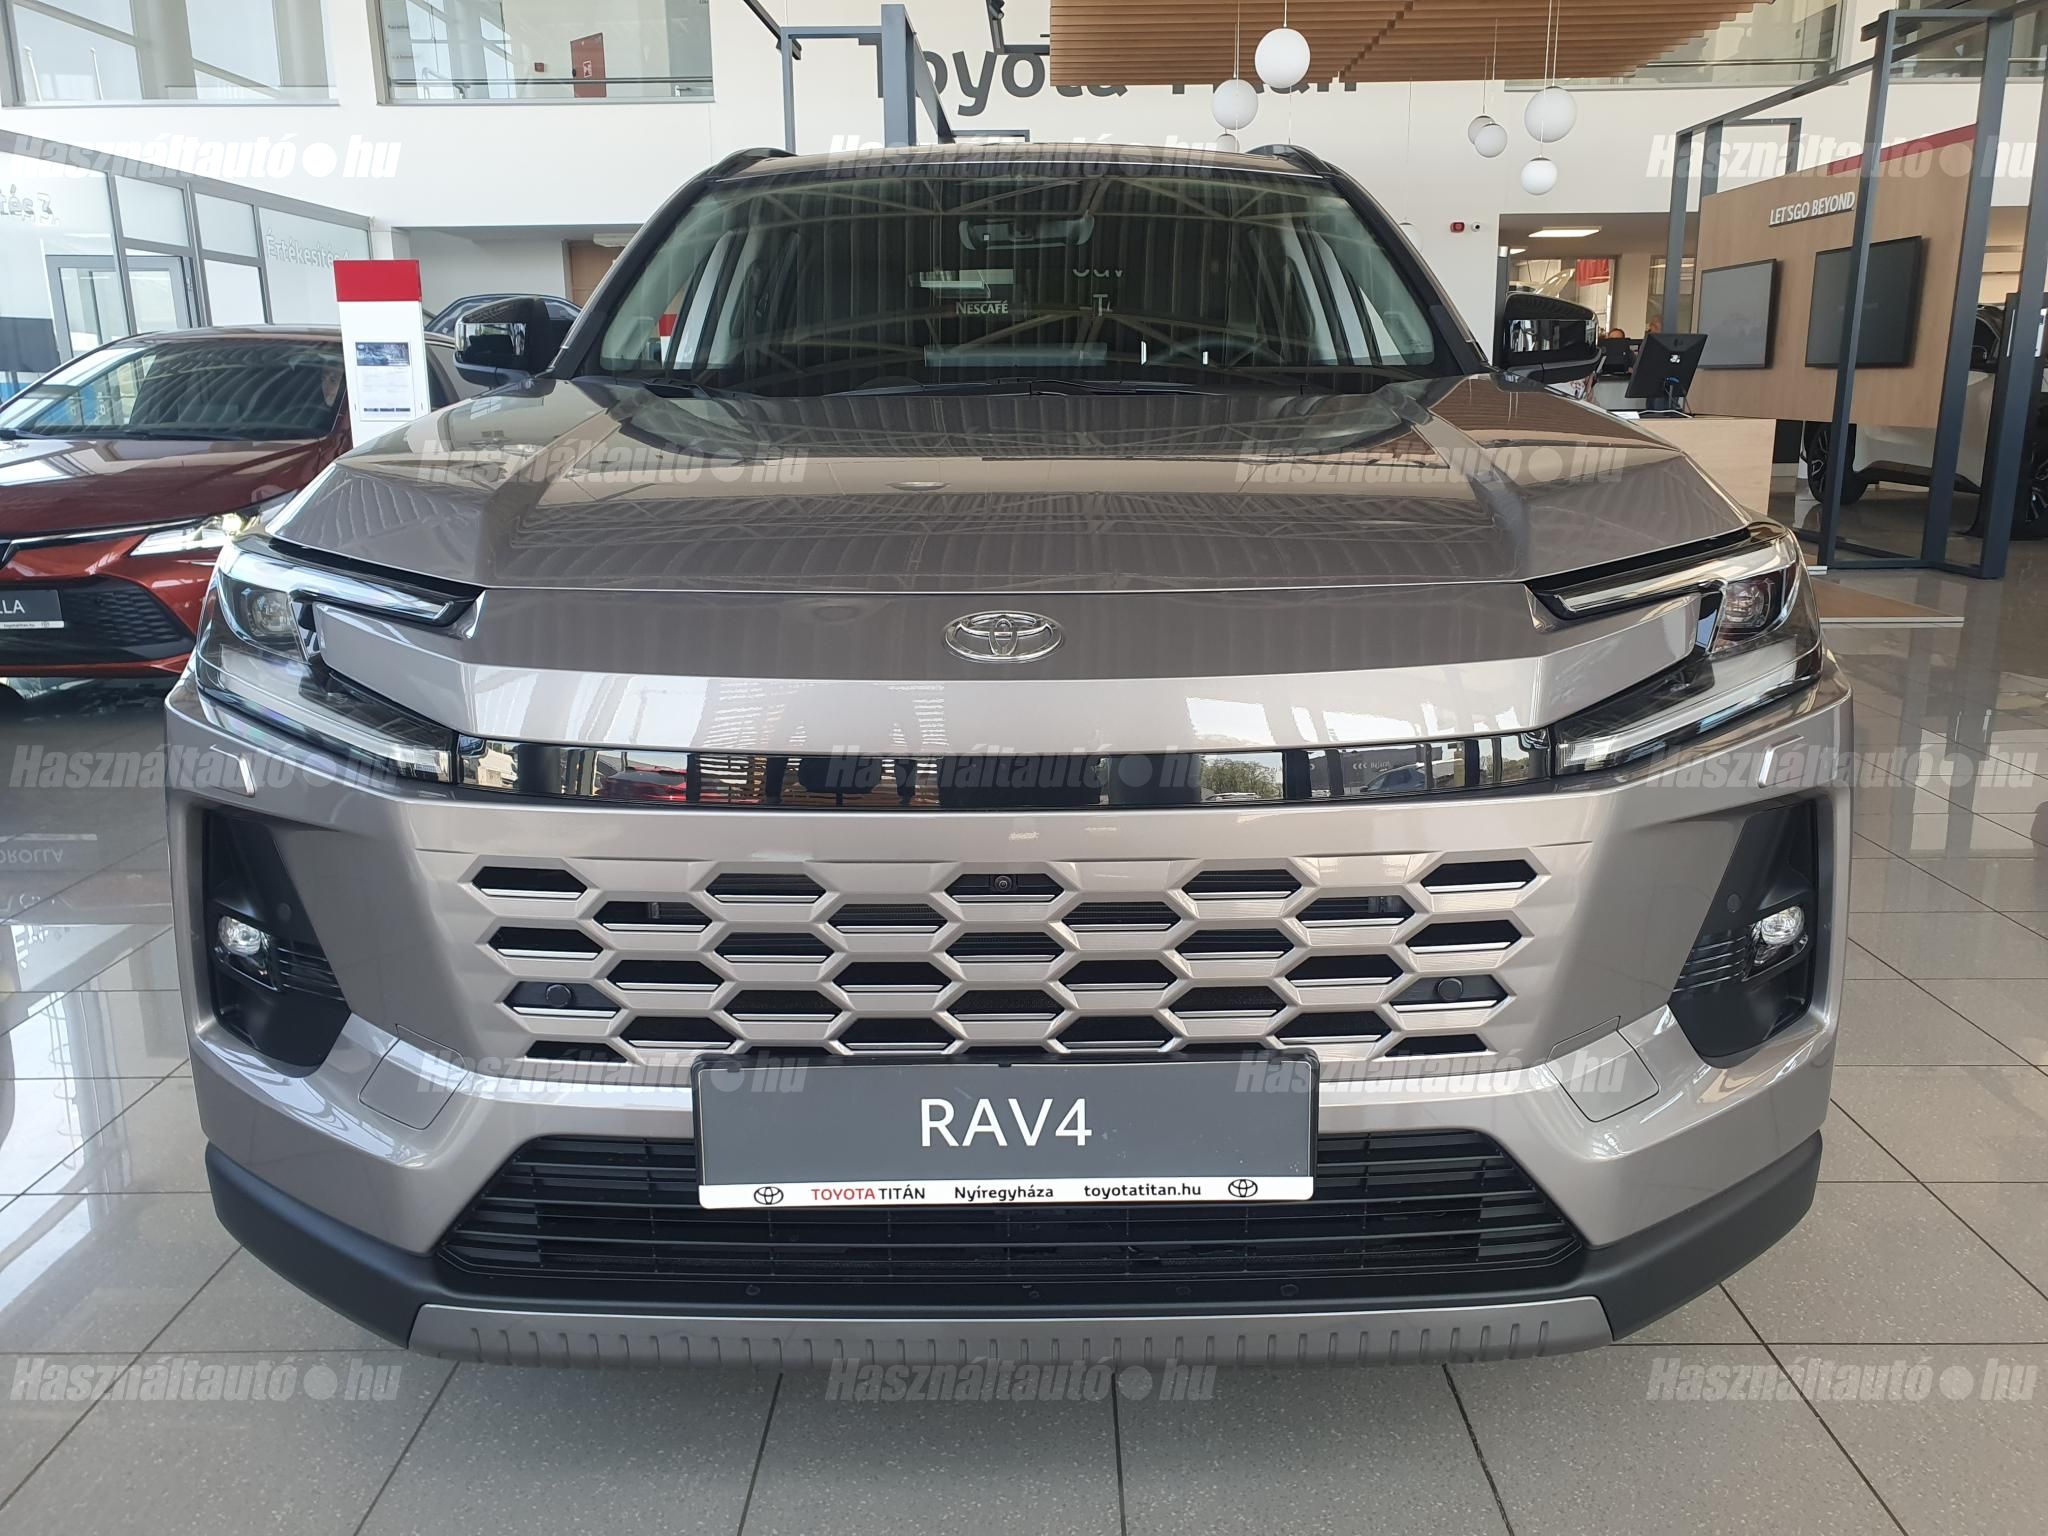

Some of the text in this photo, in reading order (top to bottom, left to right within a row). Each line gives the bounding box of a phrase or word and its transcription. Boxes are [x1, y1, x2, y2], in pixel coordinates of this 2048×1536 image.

[1793, 201, 1810, 220] GO
[1811, 191, 1856, 217] BEYOND
[921, 1098, 1093, 1147] RAV4
[812, 1182, 1201, 1203] TOYOTA TITÁN Nyíregyháza toyotatitan.hu
